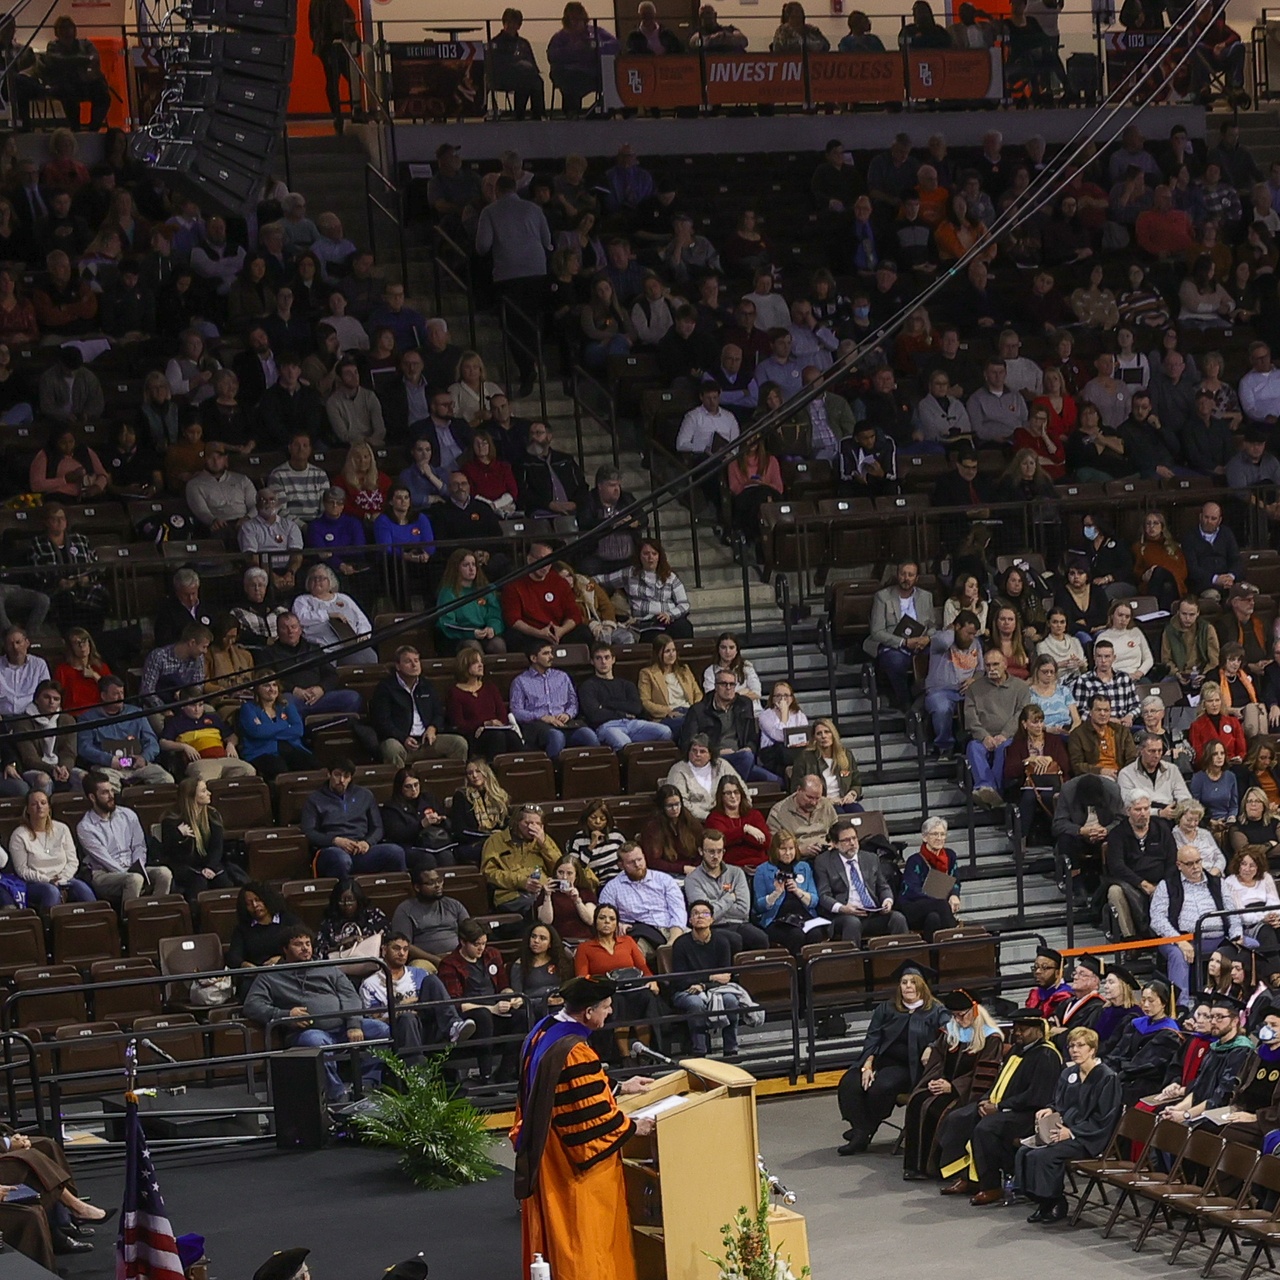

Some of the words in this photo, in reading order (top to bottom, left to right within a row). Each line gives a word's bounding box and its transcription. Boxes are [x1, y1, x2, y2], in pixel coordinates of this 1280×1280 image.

[1129, 33, 1145, 48] 103
[438, 43, 457, 59] 103
[709, 61, 778, 83] INVEST
[781, 61, 802, 81] IN
[813, 59, 894, 80] SUCCESS
